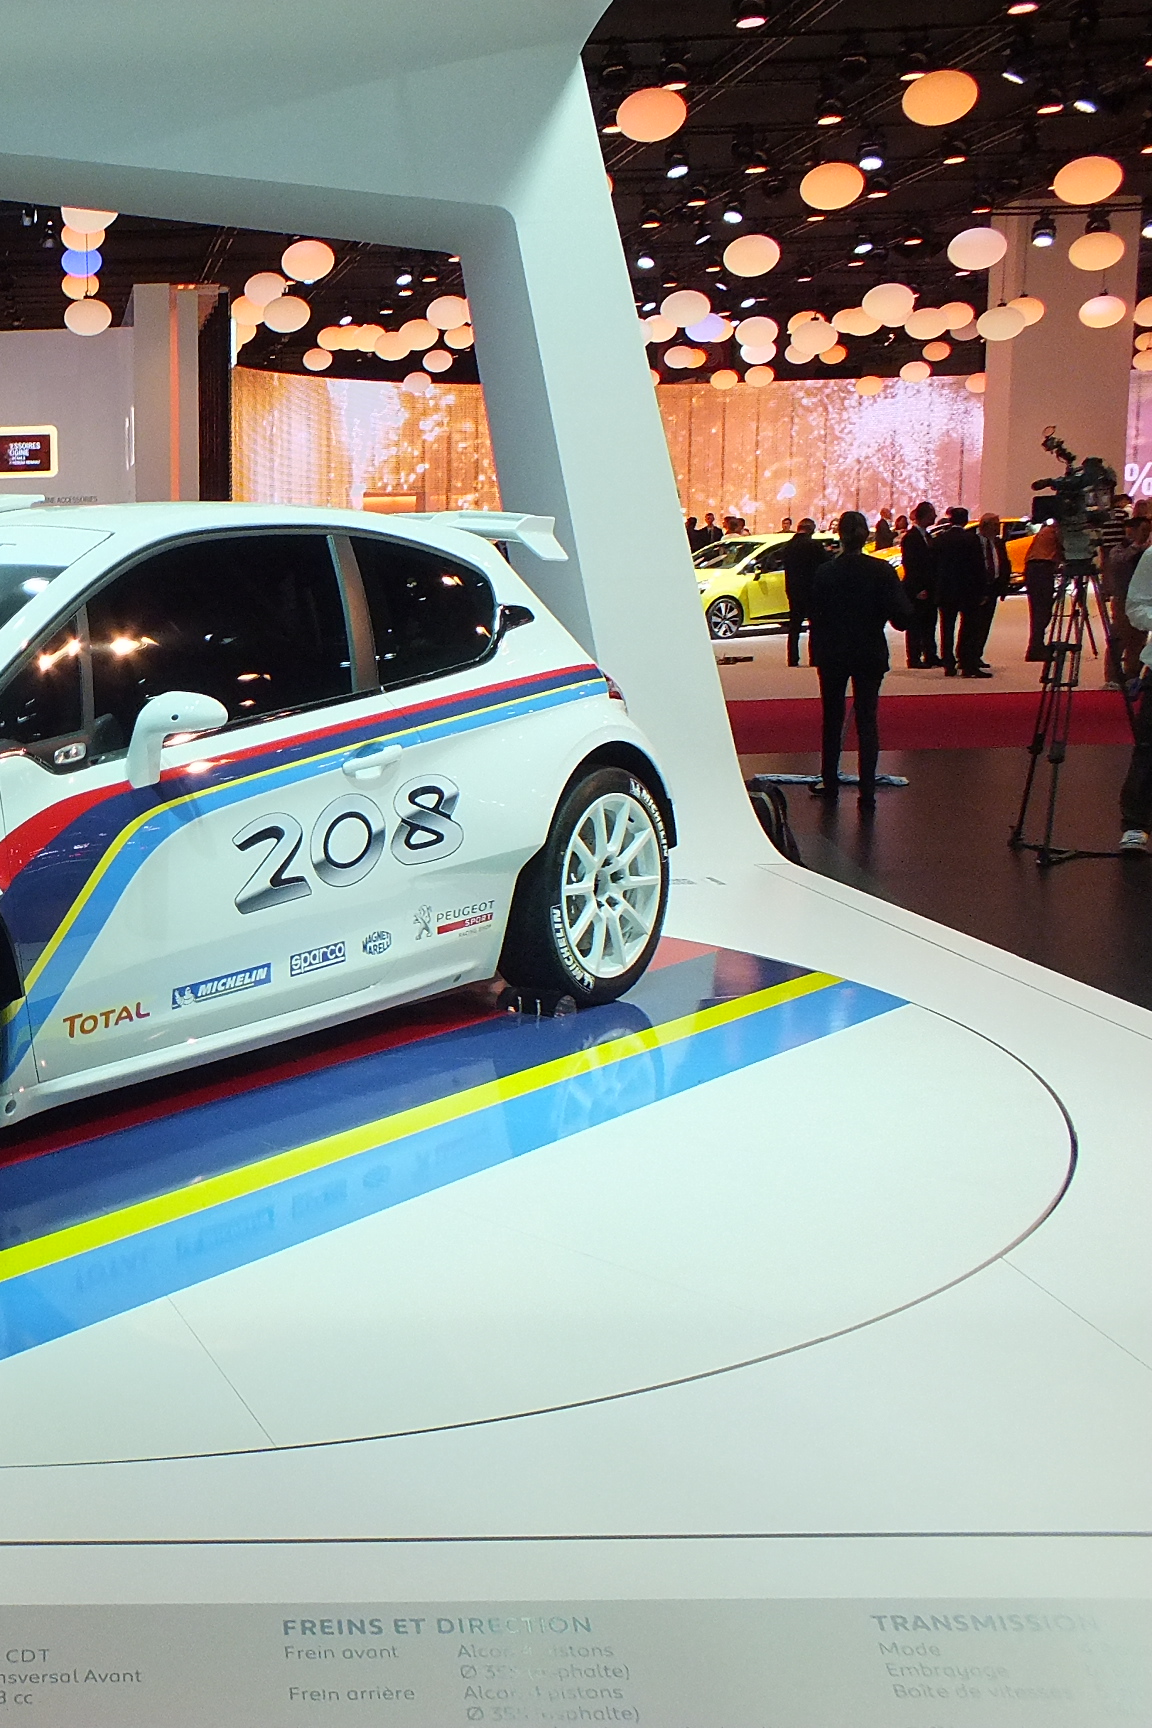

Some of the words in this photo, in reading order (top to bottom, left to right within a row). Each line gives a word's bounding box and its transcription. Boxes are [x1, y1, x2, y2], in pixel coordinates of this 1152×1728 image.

[231, 773, 465, 915] 208
[436, 899, 496, 923] PEUGEOT
[464, 913, 493, 928] SPORT
[551, 908, 584, 981] MICHELIN
[291, 942, 344, 973] sparco
[196, 965, 269, 998] MICHELIN
[62, 1001, 151, 1039] TOTAL
[282, 1617, 384, 1636] FREINS
[394, 1617, 427, 1636] ET
[437, 1615, 592, 1636] DIRECTION
[870, 1614, 1102, 1633] TRANSMISSION
[5, 1648, 51, 1663] CDT
[284, 1645, 335, 1660] Frein
[341, 1645, 400, 1660] avant
[548, 1645, 615, 1660] istons
[877, 1641, 942, 1657] Mode
[83, 1668, 143, 1684] Avant
[885, 1661, 1011, 1681] Embrayage
[13, 1693, 34, 1705] cc
[288, 1686, 341, 1702] Frein
[346, 1686, 416, 1702] arrière
[548, 1686, 624, 1702] pistons
[892, 1682, 951, 1699] Boîte
[955, 1683, 982, 1699] de
